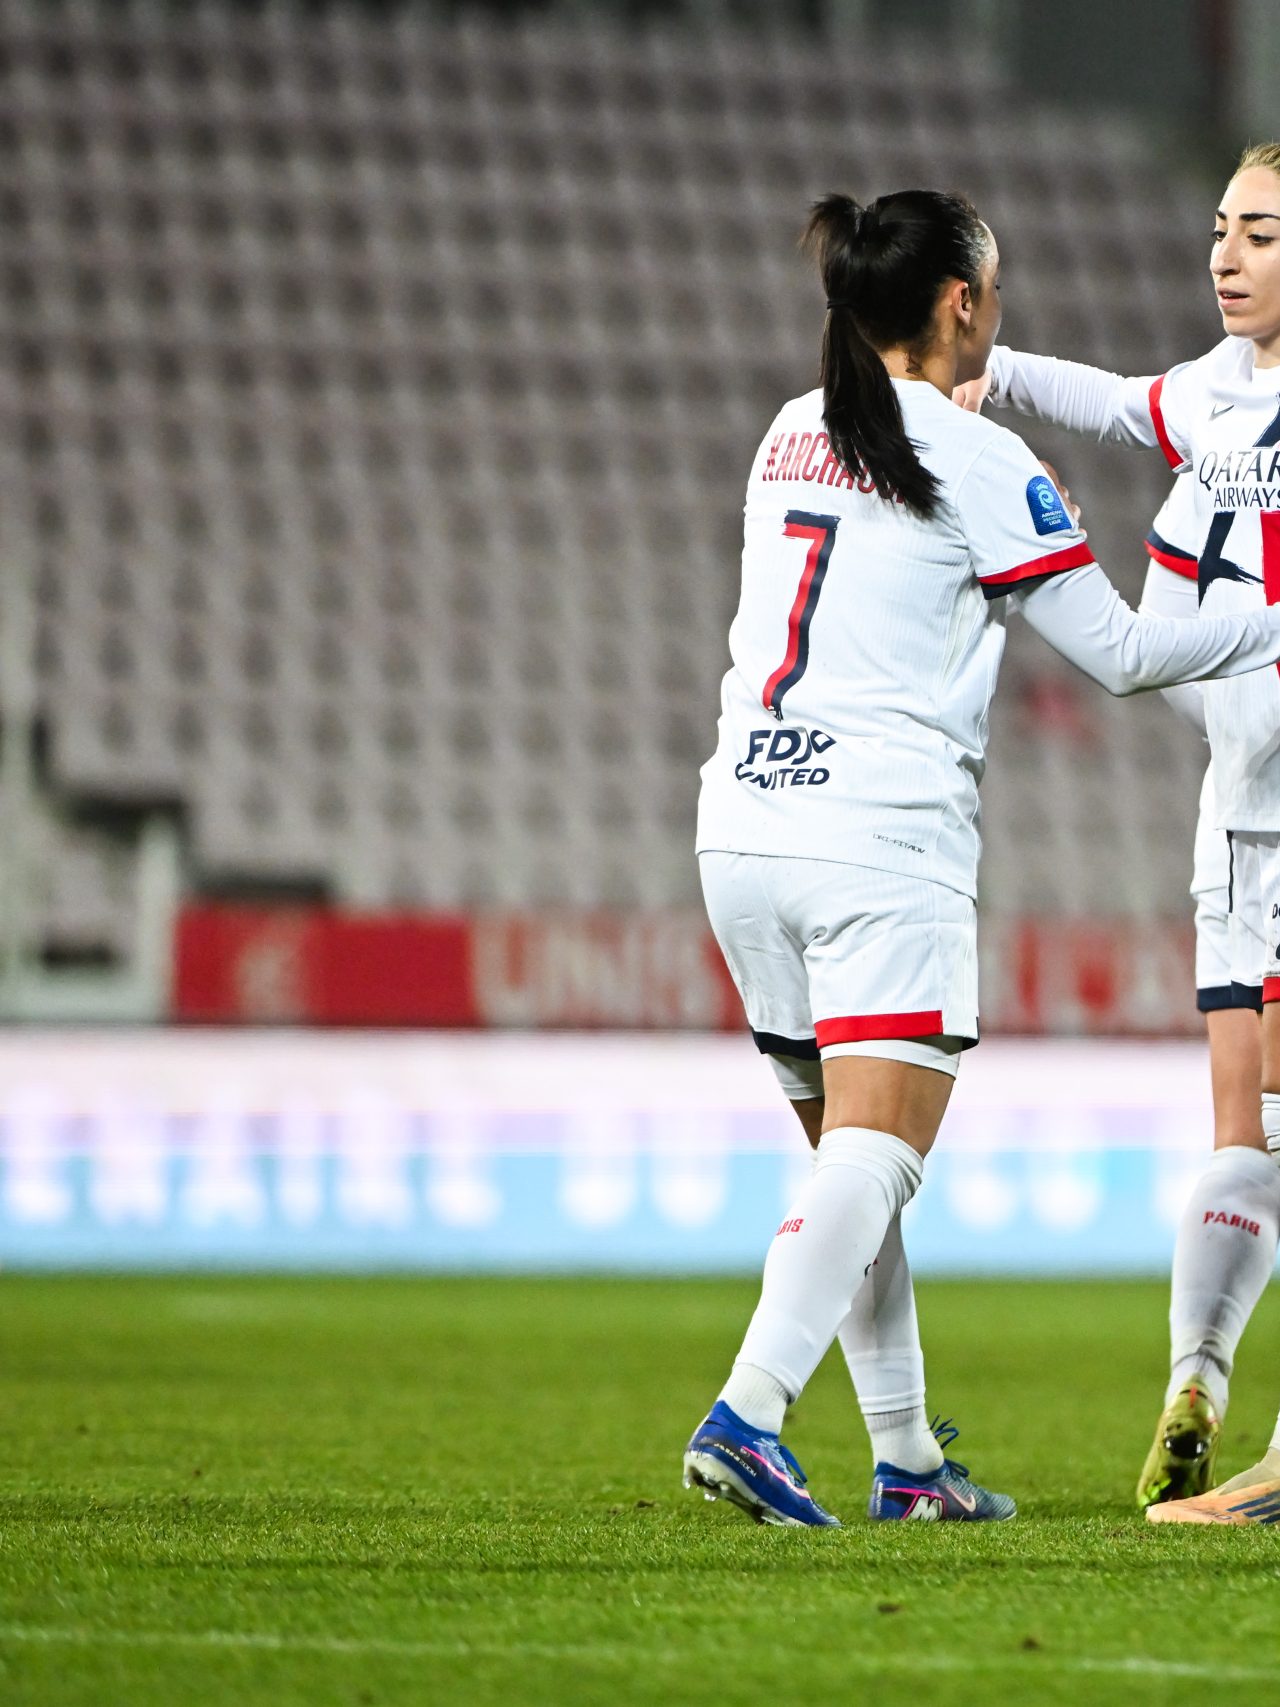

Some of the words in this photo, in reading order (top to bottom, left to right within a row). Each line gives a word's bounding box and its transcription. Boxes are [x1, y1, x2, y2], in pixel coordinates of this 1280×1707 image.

[763, 509, 842, 721] 7
[735, 762, 830, 790] UNITED
[1203, 1211, 1261, 1236] PARIS
